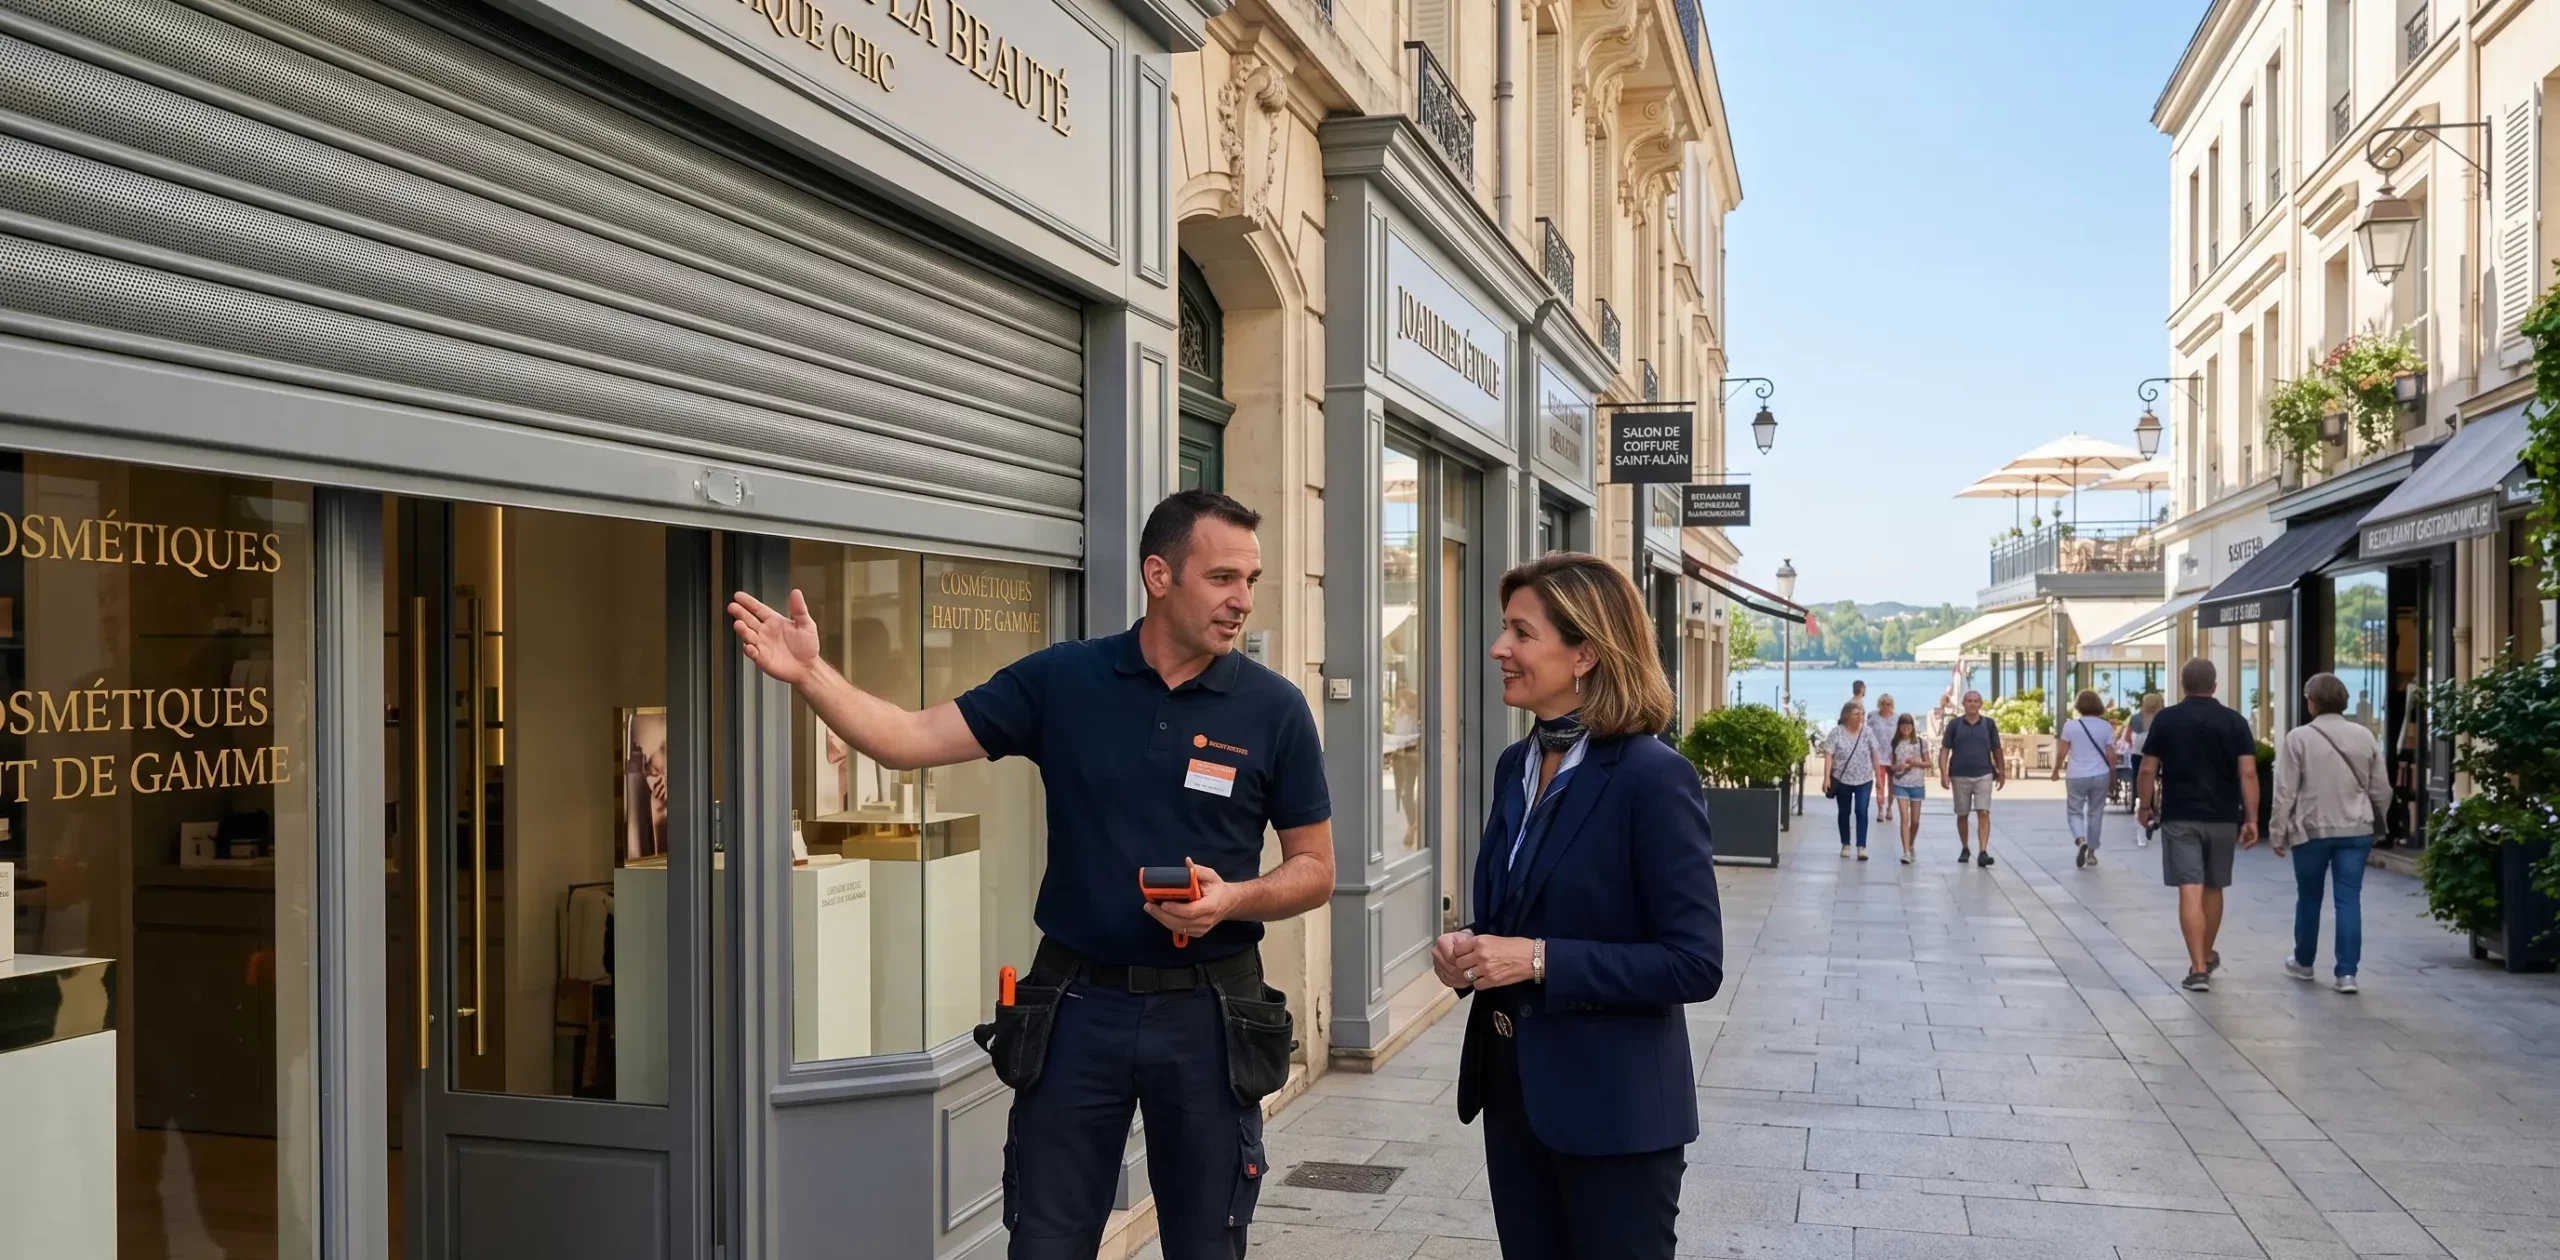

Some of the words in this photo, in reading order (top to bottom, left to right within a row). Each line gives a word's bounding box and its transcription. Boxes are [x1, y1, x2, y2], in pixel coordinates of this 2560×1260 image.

[832, 23, 895, 92] CHIC
[946, 0, 1072, 137] BEAUTÉ
[1623, 427, 1661, 438] SALON
[1664, 426, 1680, 437] DE
[1623, 440, 1680, 452] COIFFURE
[941, 570, 1032, 605] COSMÉTIQUES
[932, 605, 971, 630] HAUT
[974, 608, 992, 631] DE
[994, 609, 1040, 633] GAMME
[0, 677, 269, 739] SMÉTIQUES
[52, 755, 118, 800] DE
[130, 746, 292, 794] GAMME
